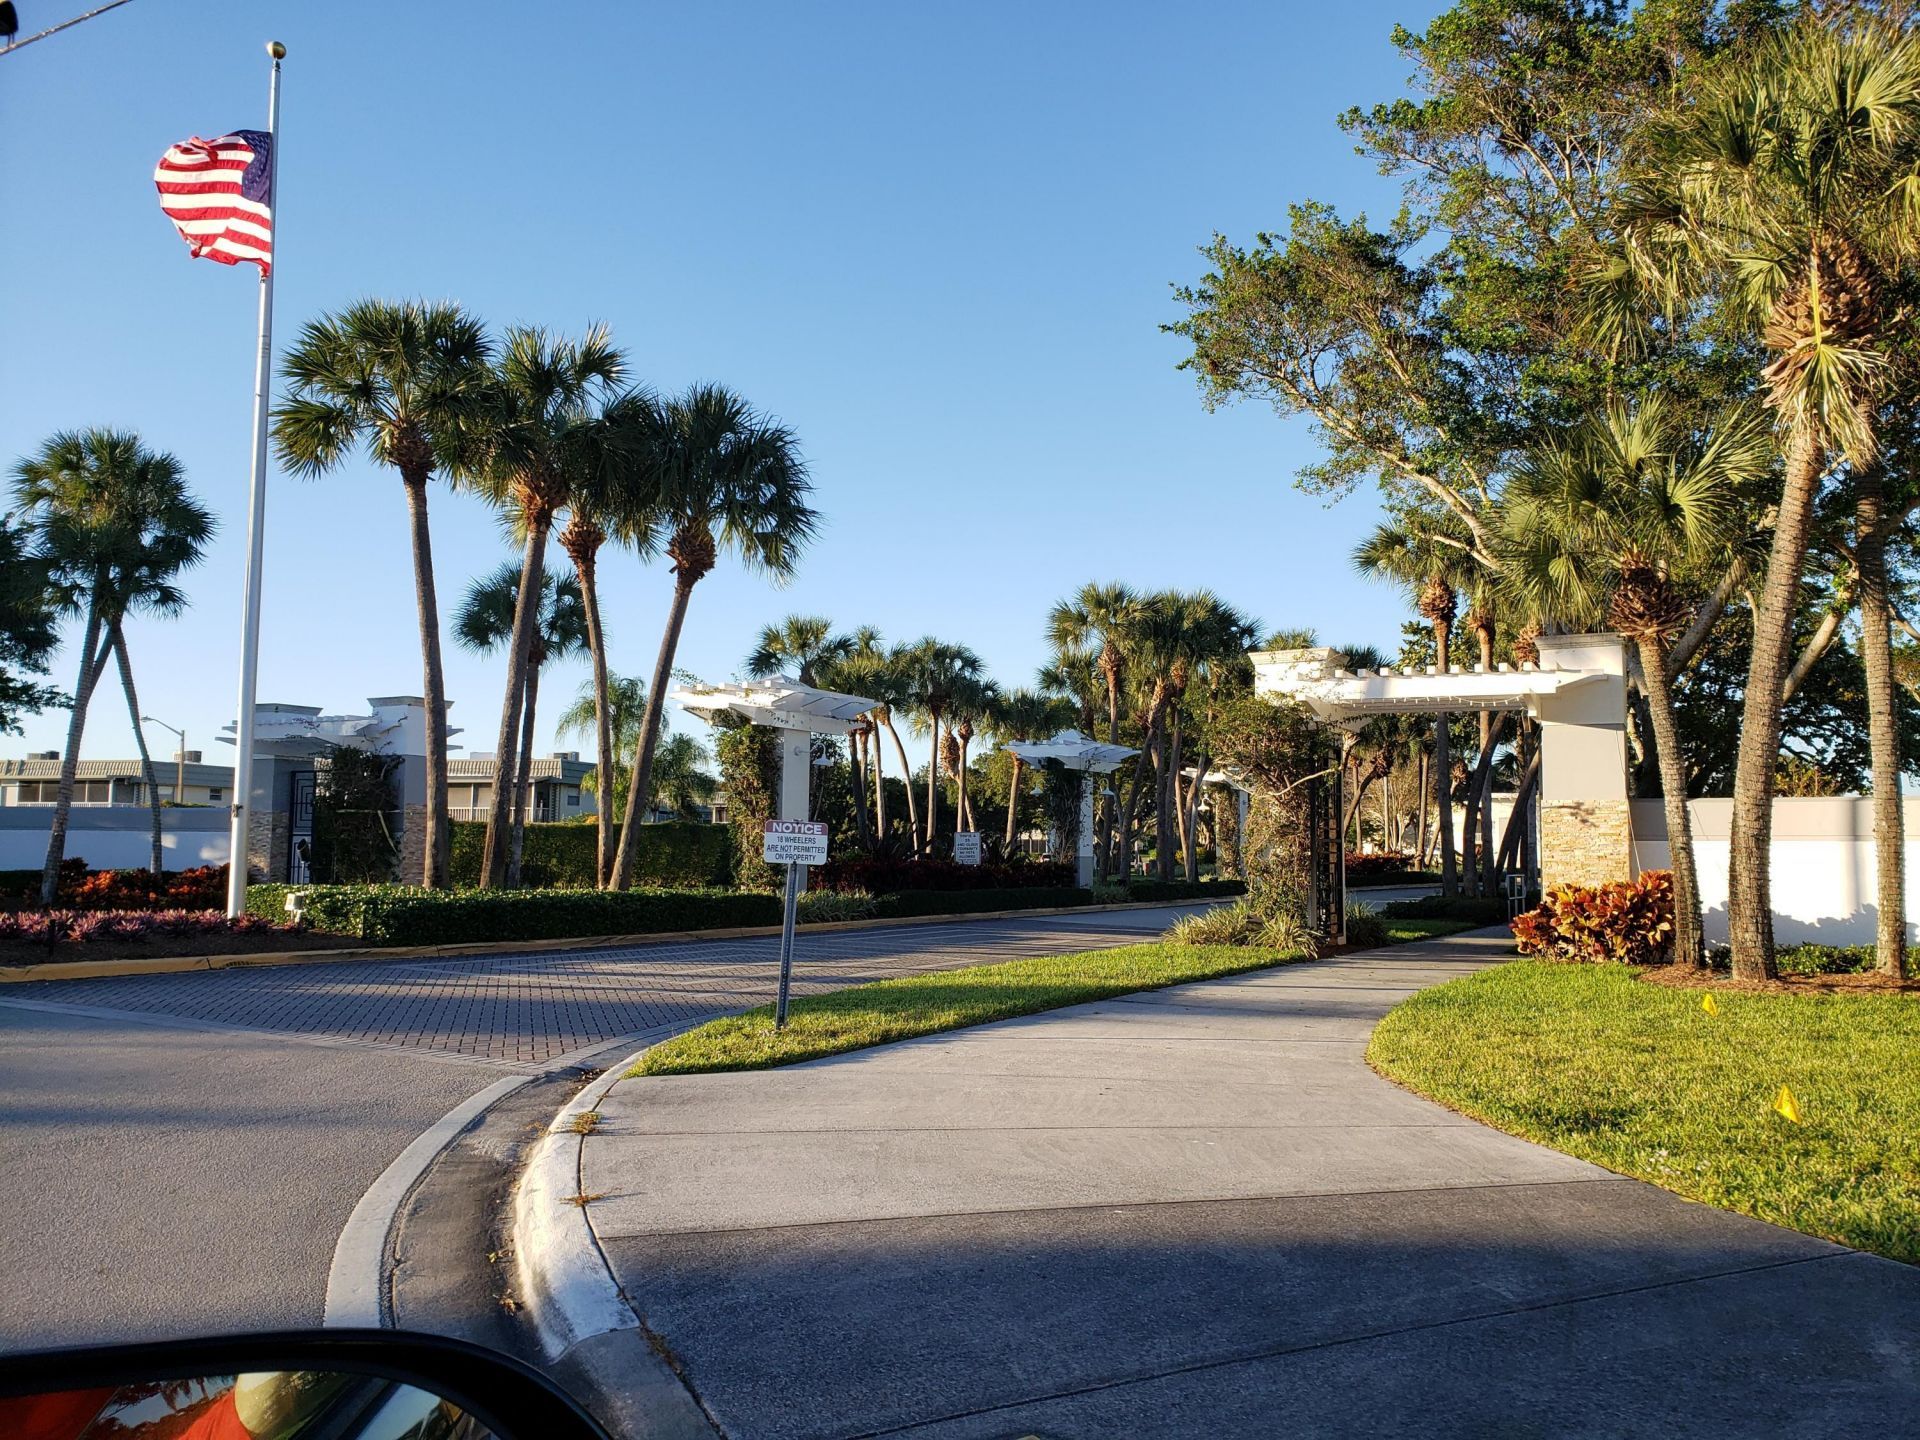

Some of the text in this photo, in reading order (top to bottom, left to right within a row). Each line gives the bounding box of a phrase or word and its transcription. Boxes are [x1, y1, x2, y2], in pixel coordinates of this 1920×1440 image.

[772, 822, 822, 834] NOTICE
[784, 837, 816, 845] WHEELERS
[785, 853, 816, 861] PROPERTY
